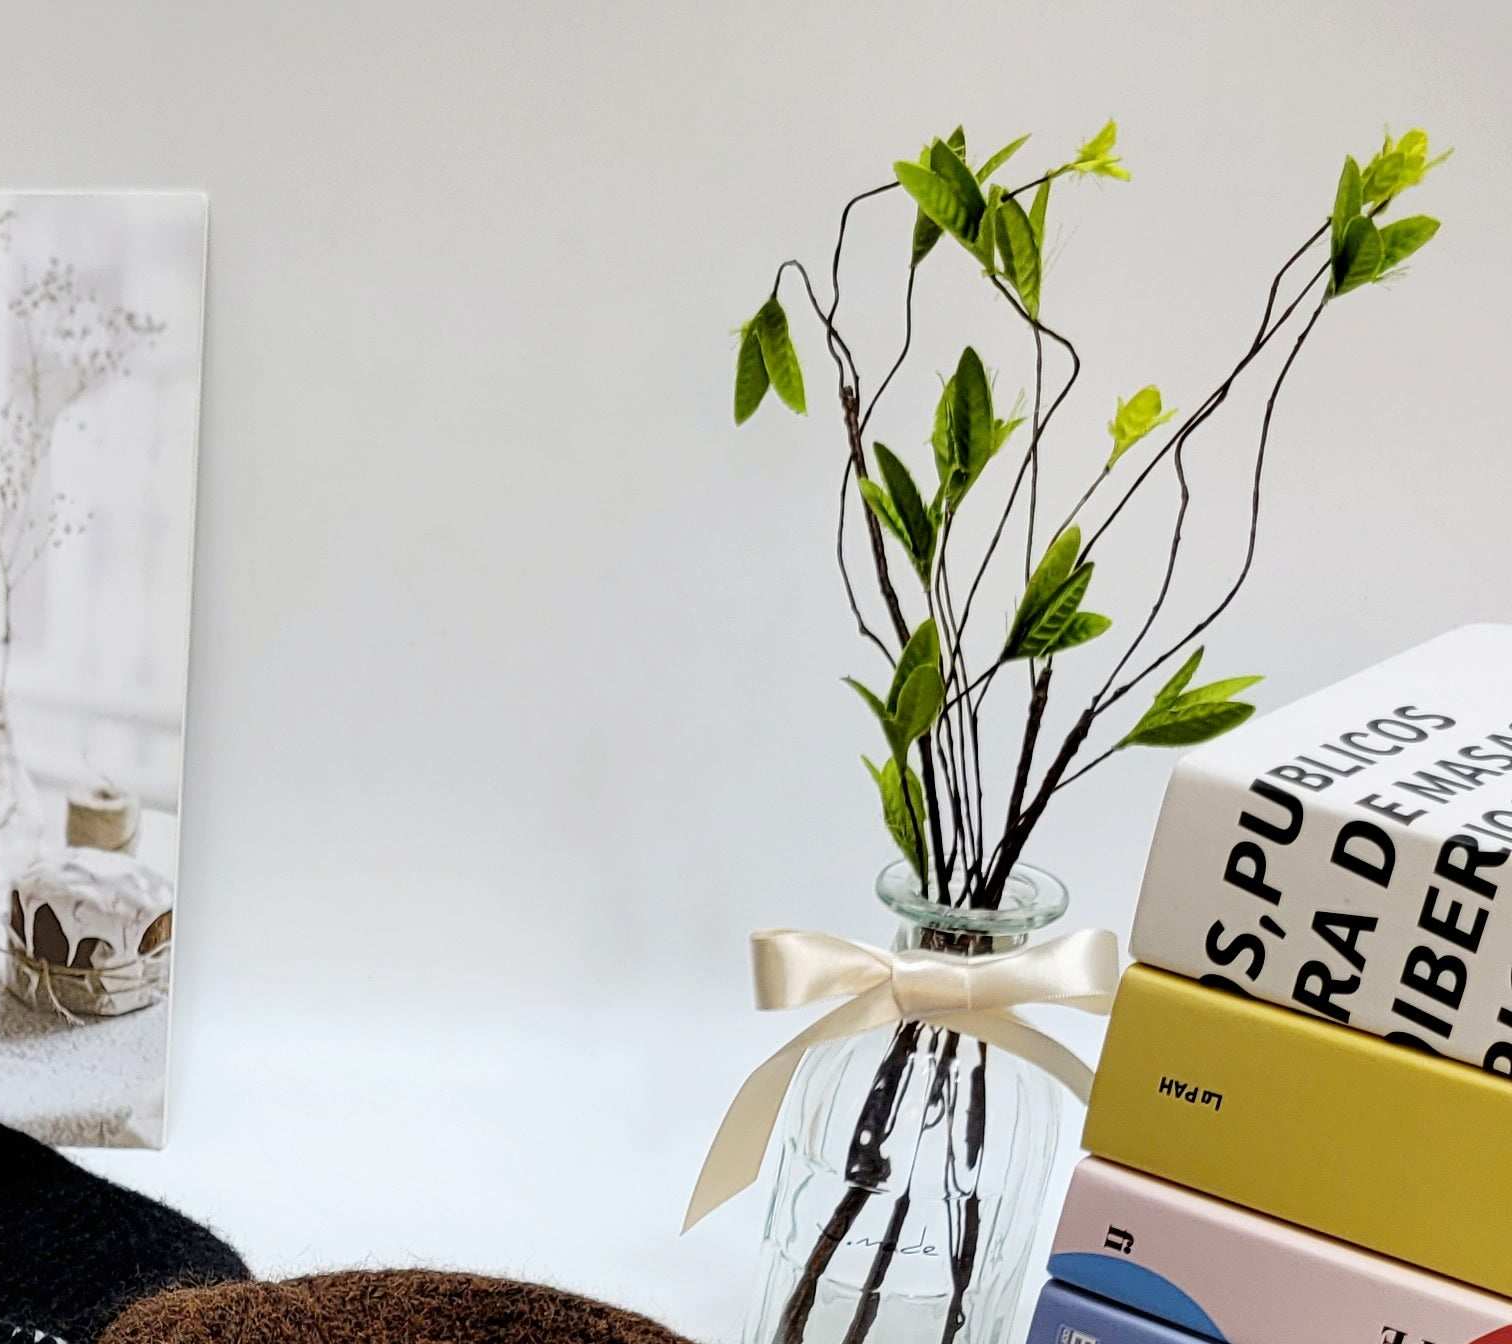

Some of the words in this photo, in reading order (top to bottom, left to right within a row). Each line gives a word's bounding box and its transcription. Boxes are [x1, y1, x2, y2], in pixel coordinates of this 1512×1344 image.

[1199, 705, 1456, 998] S,PUBLICOS
[1329, 793, 1429, 890] DE
[1158, 1076, 1199, 1104] PAH
